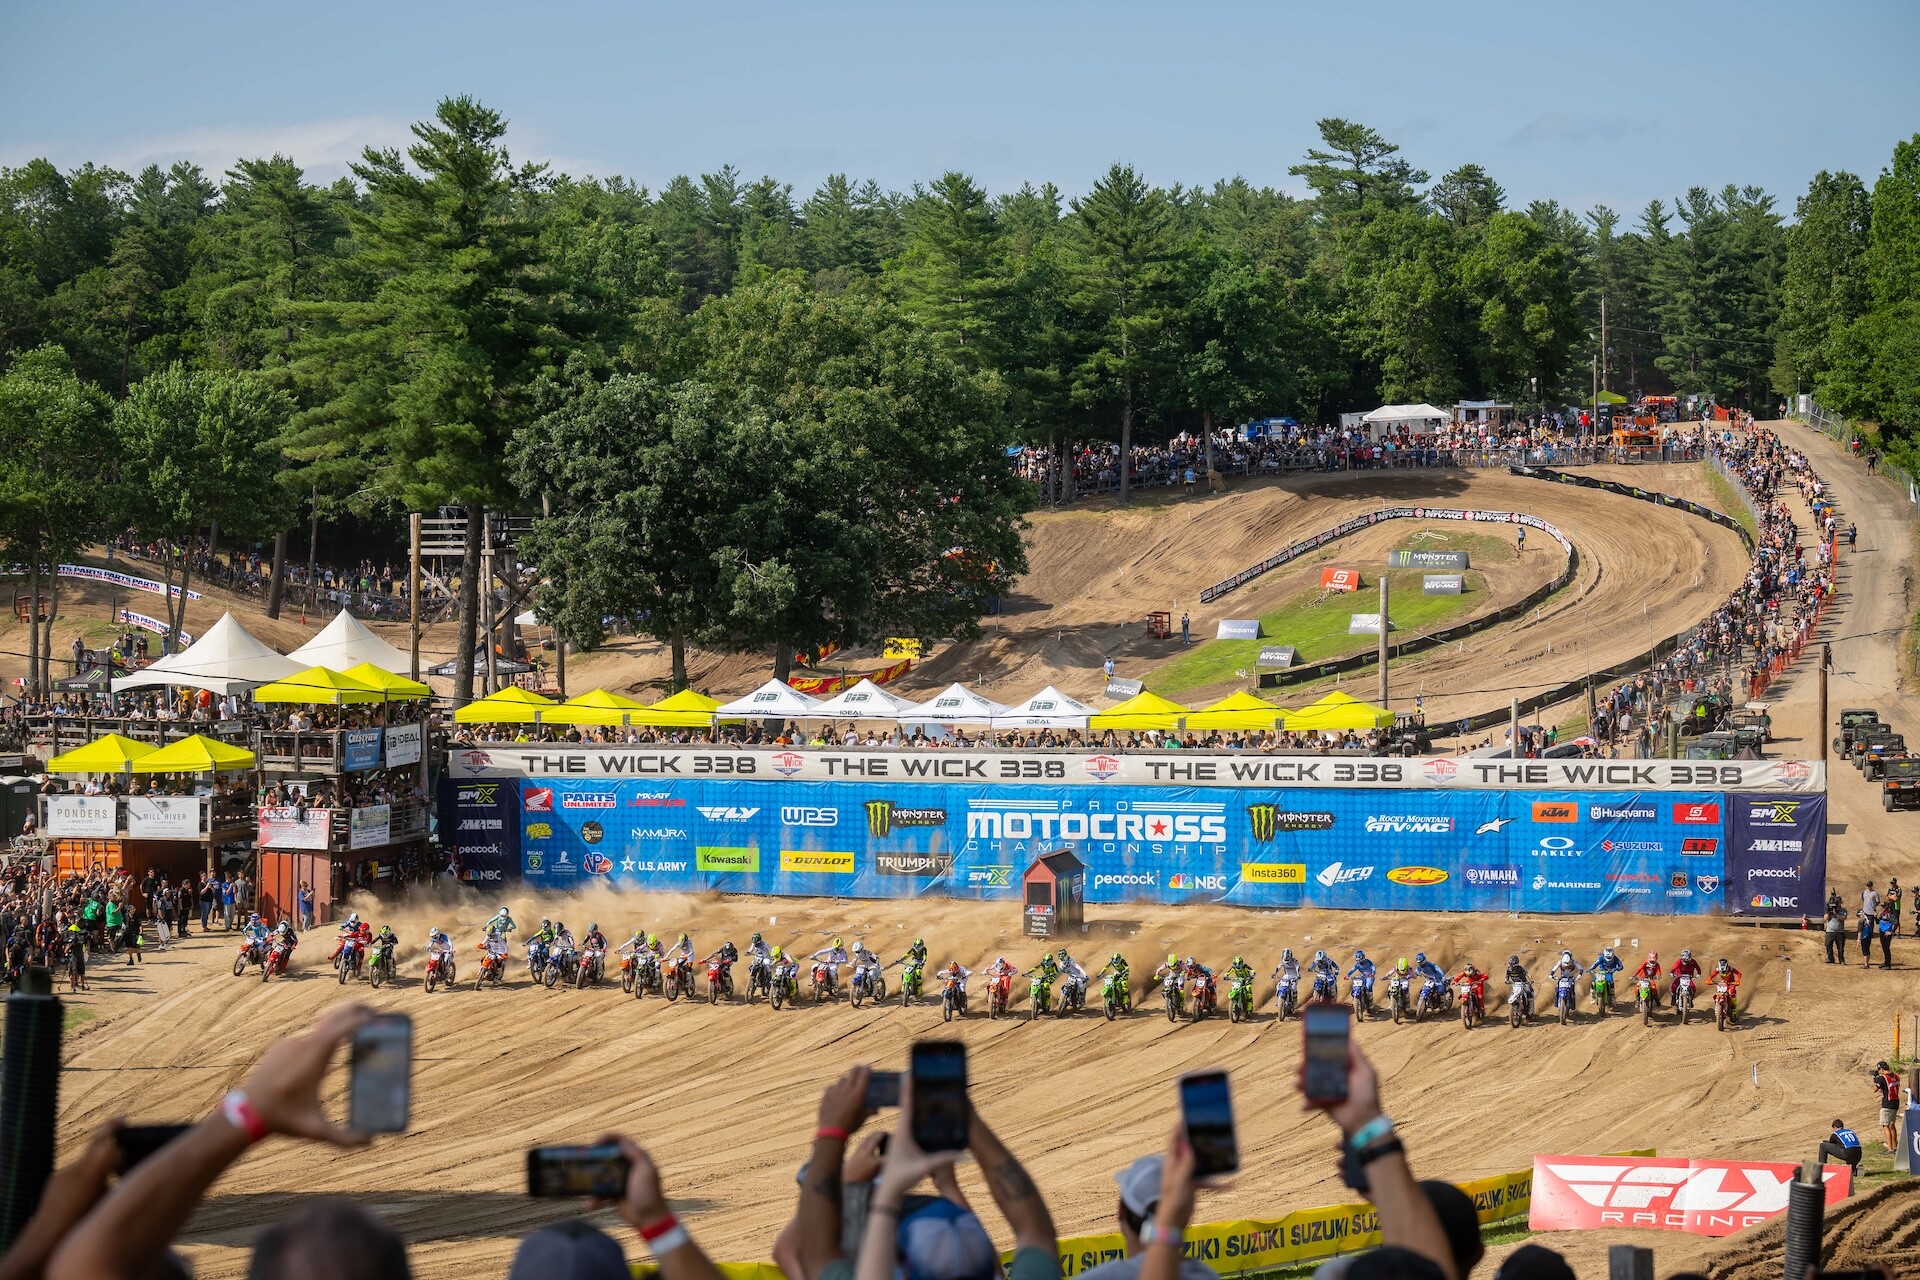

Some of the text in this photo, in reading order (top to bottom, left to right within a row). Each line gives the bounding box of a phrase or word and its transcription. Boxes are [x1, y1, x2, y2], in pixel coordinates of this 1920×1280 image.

[1413, 553, 1458, 561] MONSTER
[74, 567, 103, 576] PARTS
[104, 571, 131, 582] PARTS
[133, 578, 160, 589] PARTS
[398, 731, 420, 744] IDEAL
[521, 756, 757, 774] THE WICK 338
[820, 757, 1065, 778] THE WICK 338
[1145, 762, 1403, 782] THE WICK 338
[1473, 764, 1743, 785] THE WICK 338
[457, 788, 499, 803] SMX
[563, 793, 616, 802] PARTS
[1062, 800, 1129, 811] PRO
[57, 808, 108, 819] PONDERS
[695, 806, 761, 819] FLY
[783, 807, 837, 825] WPS
[891, 808, 945, 819] MONSTER
[1277, 812, 1333, 823] MONSTER
[1540, 807, 1569, 817] KTM
[1601, 807, 1655, 819] Husqvarna
[1749, 805, 1797, 822] SMX
[456, 820, 487, 830] AMA
[967, 811, 1227, 843] MOTOCROSS
[631, 827, 687, 838] NAMURA
[459, 843, 499, 855] peacock
[967, 840, 1227, 855] CHAMPIONSHIP
[1615, 841, 1663, 851] SUZUKI
[1747, 839, 1783, 851] AMA
[1531, 849, 1582, 857] OAKLEY
[532, 859, 539, 867] 2
[703, 854, 752, 865] Kawasaki
[793, 856, 851, 865] DUNLOP
[877, 857, 936, 871] TRIUMPH
[638, 862, 687, 871] U.S. ARMY
[480, 870, 502, 880] NBC
[968, 869, 1011, 885] SMX
[1251, 868, 1297, 878] Insta360
[1336, 866, 1375, 880] UFO
[1387, 869, 1449, 881] FMF
[1479, 869, 1518, 881] YAMAHA
[1605, 873, 1661, 882] HONDA
[1748, 865, 1797, 881] peacock
[1094, 871, 1155, 889] peacock
[1195, 876, 1227, 891] NBC
[1548, 881, 1601, 889] MARINES
[1673, 877, 1686, 886] 66
[1615, 886, 1651, 894] Generators
[1772, 896, 1798, 908] NBC
[1844, 1133, 1855, 1142] 19
[1547, 1163, 1838, 1213] FLY
[1601, 1211, 1769, 1229] RACING
[1291, 1217, 1348, 1246] SUZUKI
[1226, 1227, 1285, 1257] SUZUKI
